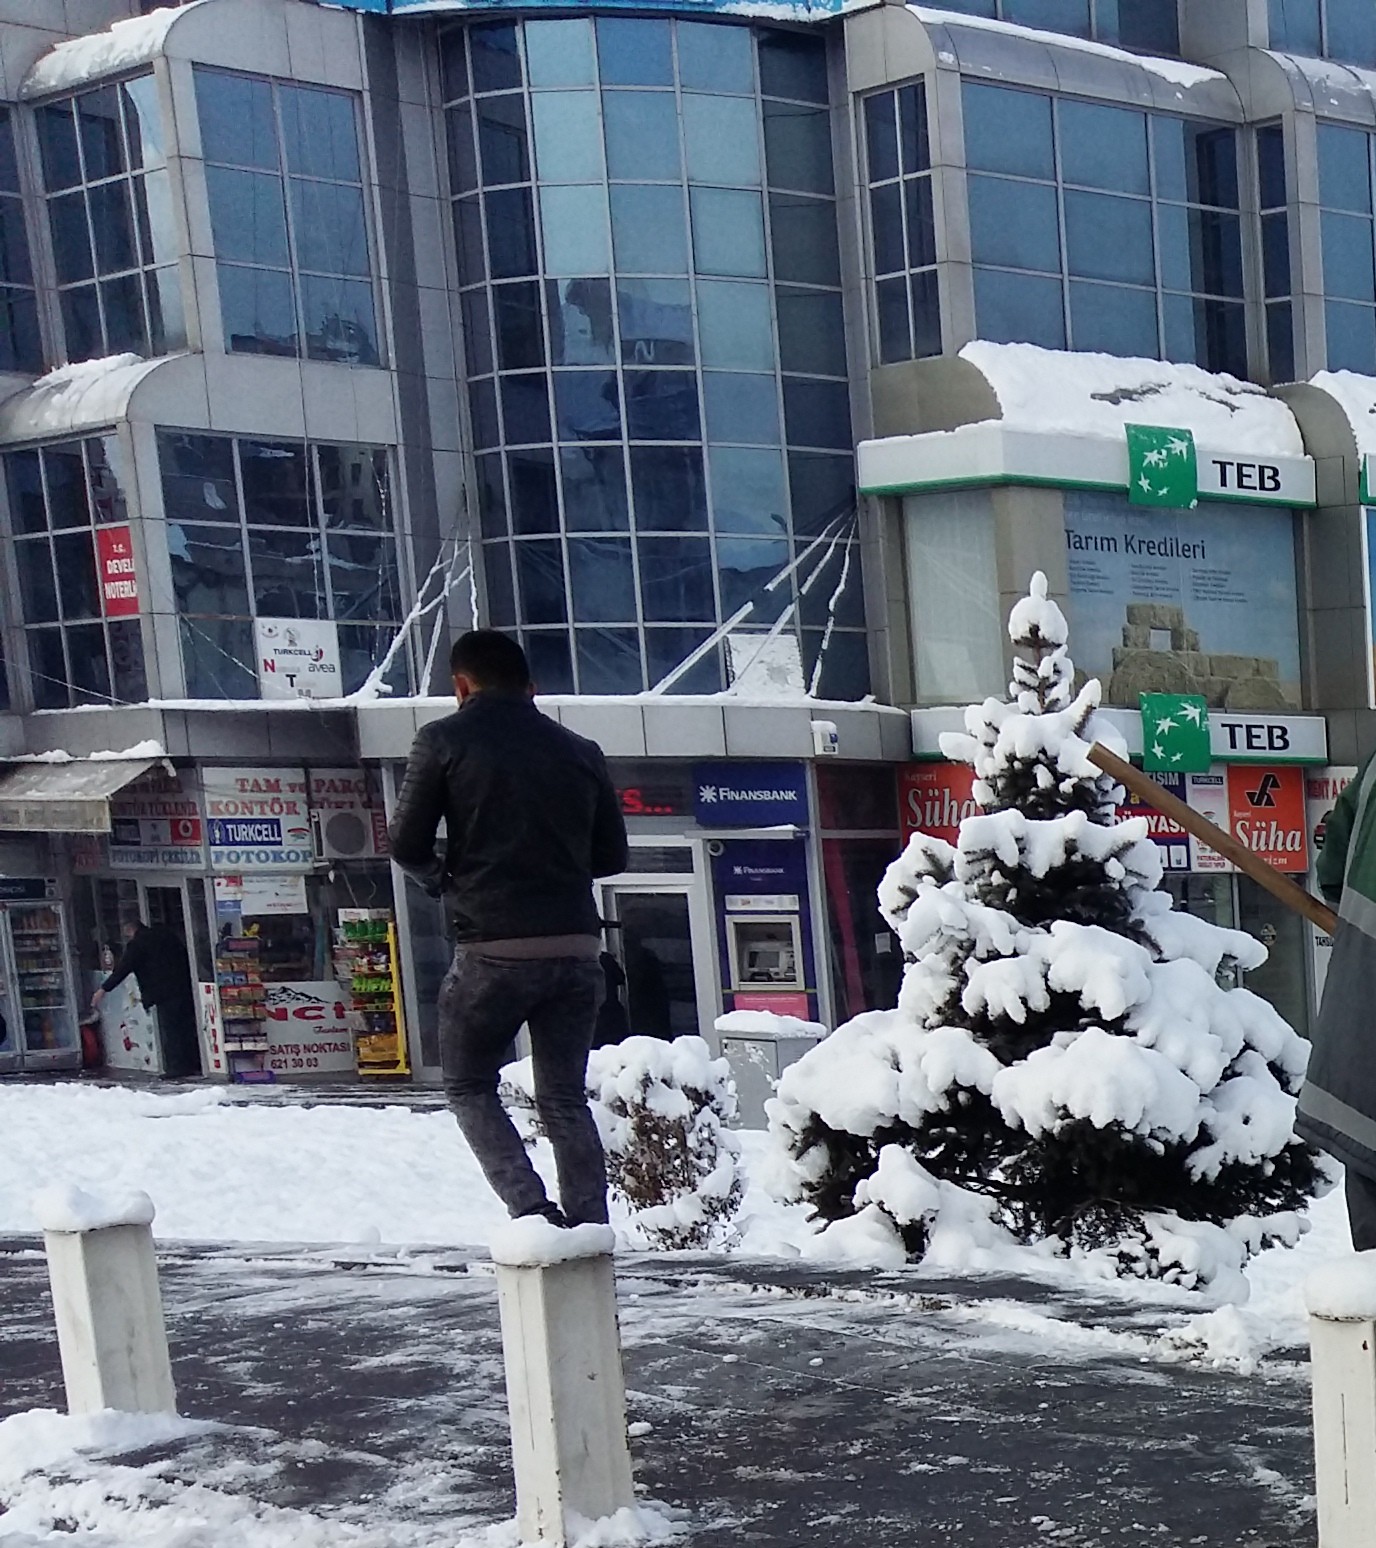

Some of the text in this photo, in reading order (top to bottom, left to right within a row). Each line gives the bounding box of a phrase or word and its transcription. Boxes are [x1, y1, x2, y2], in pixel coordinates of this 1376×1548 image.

[1212, 459, 1282, 492] TEB
[1064, 528, 1206, 560] Tarım Kredileri
[308, 663, 336, 673] avea
[1221, 723, 1290, 751] TEB
[235, 778, 282, 793] TAM
[209, 797, 300, 816] KONTÖR
[226, 824, 282, 842] TURKCELL
[1236, 820, 1302, 852] Süha
[270, 1043, 301, 1056] SATIŞ
[271, 1059, 288, 1069] 621
